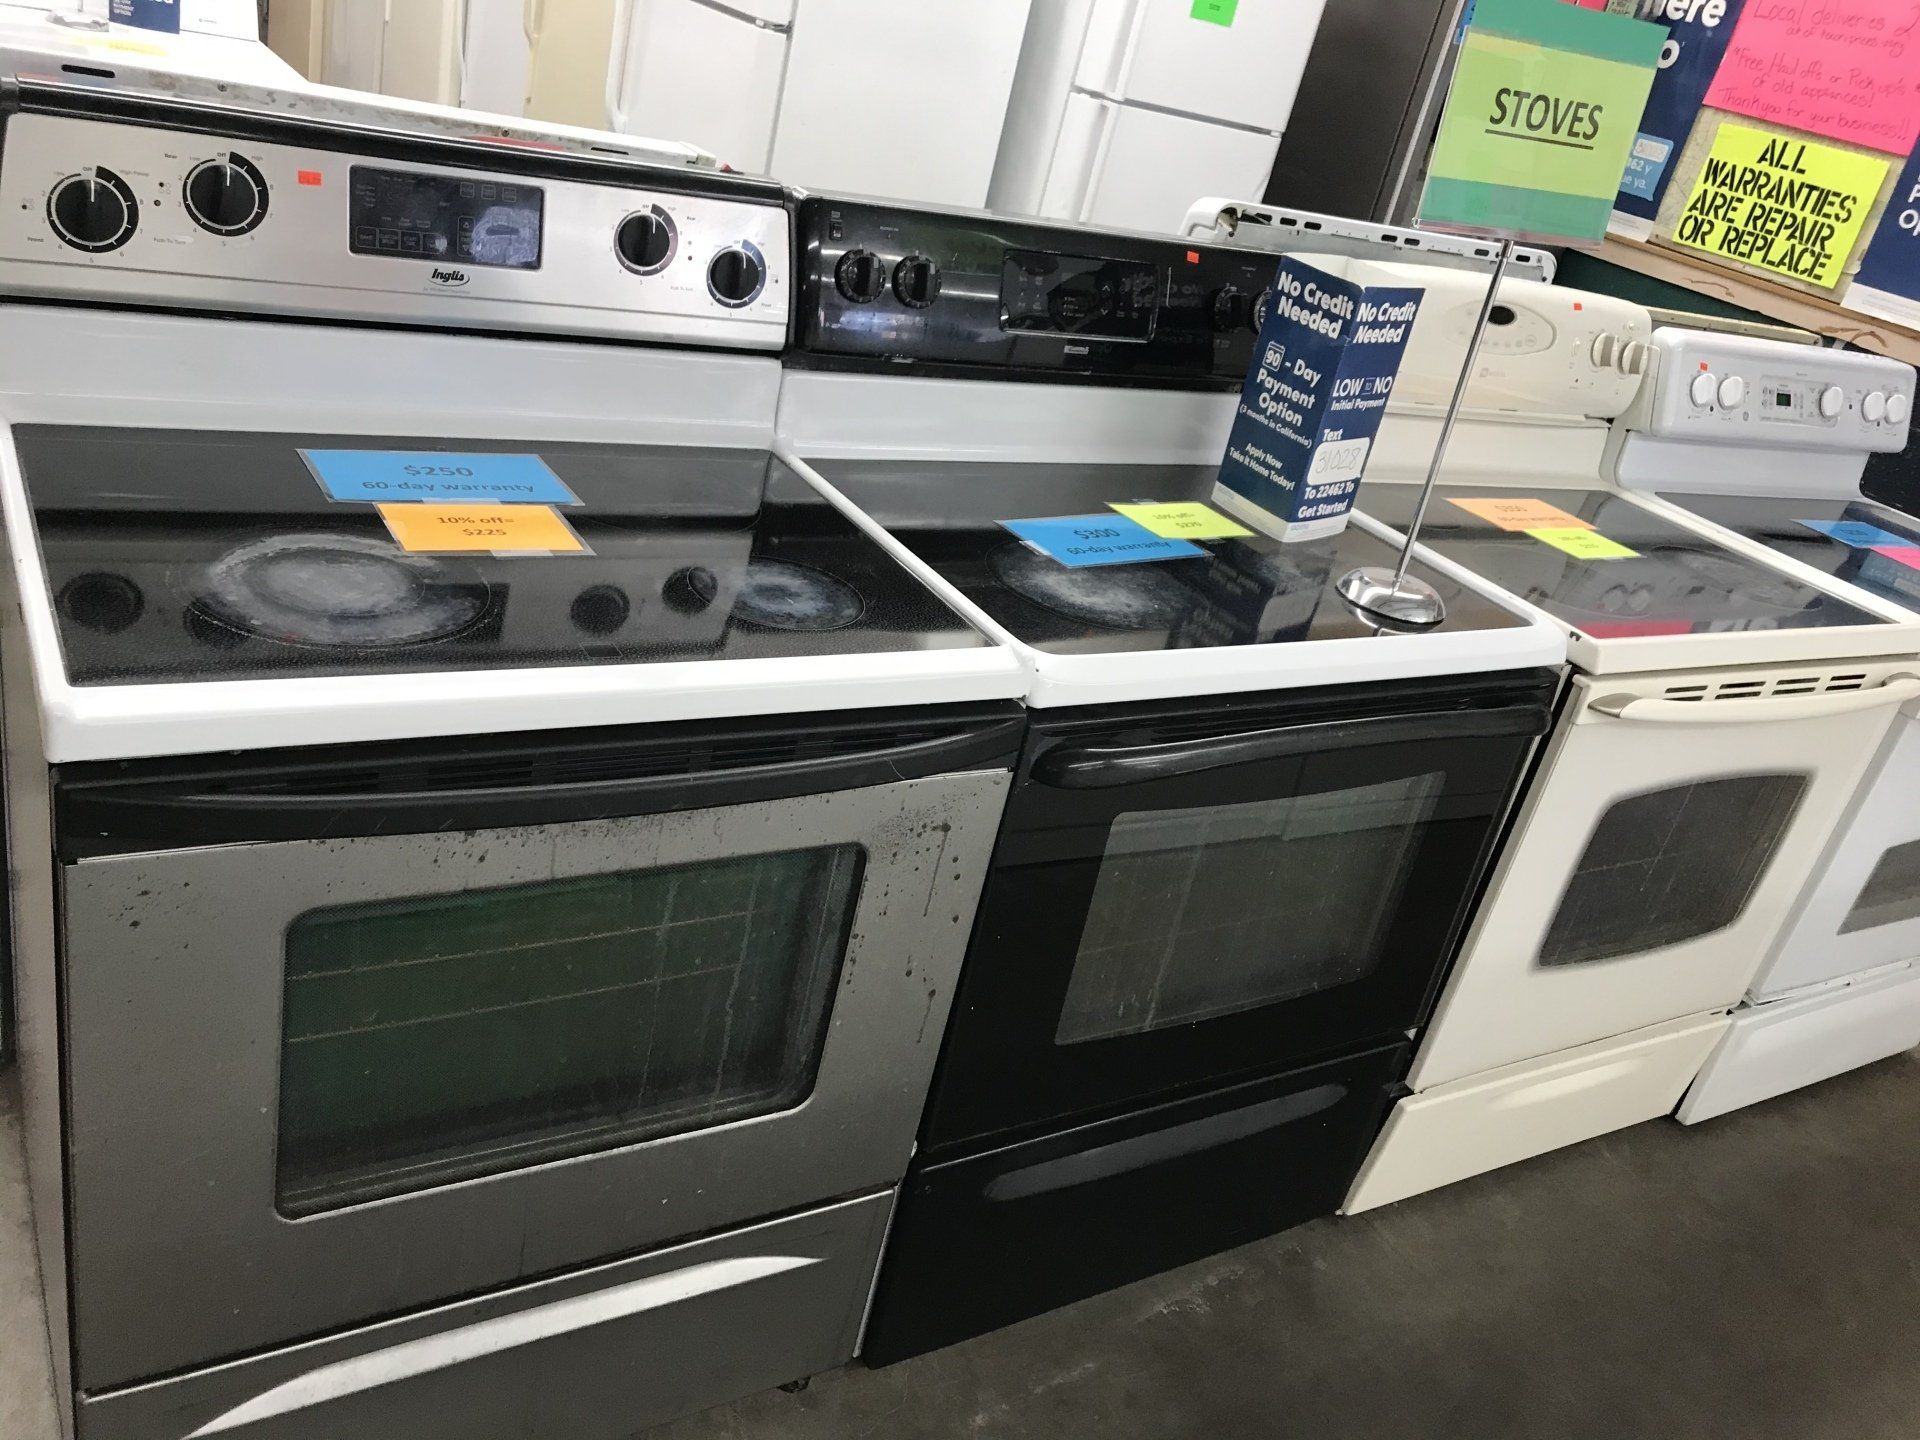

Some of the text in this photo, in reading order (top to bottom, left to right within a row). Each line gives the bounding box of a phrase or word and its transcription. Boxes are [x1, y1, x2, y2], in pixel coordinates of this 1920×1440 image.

[1489, 87, 1604, 141] STOVES
[1756, 138, 1807, 175] ALL
[1703, 157, 1858, 224] WARRANTIES
[1687, 188, 1836, 251] ARE REPAIR
[1678, 214, 1833, 281] OR REPLACE
[432, 268, 464, 282] Inglis
[1277, 271, 1354, 319] No Credit
[1277, 295, 1343, 339] Needed
[1357, 301, 1417, 323] No Credit
[1353, 323, 1406, 344] Needed
[1265, 350, 1281, 367] 90
[1294, 359, 1322, 387] Day
[1256, 368, 1316, 409] Payment
[1332, 377, 1365, 397] LOW
[1372, 376, 1393, 394] NO
[1259, 392, 1303, 427] Option
[1331, 397, 1386, 412] Initial Payment
[1322, 428, 1344, 442] Text
[1245, 443, 1283, 469] Apply Now
[403, 465, 474, 477] $250
[1249, 459, 1270, 477] Home
[1270, 470, 1296, 491] Today!
[362, 481, 534, 493] 60-day warranty
[1304, 486, 1316, 500] To
[1316, 482, 1345, 499] 22462
[1298, 499, 1350, 518] Get Started
[437, 516, 476, 524] 10%
[462, 528, 507, 536] $225
[1073, 528, 1121, 540] $300
[1113, 541, 1173, 551] warranty
